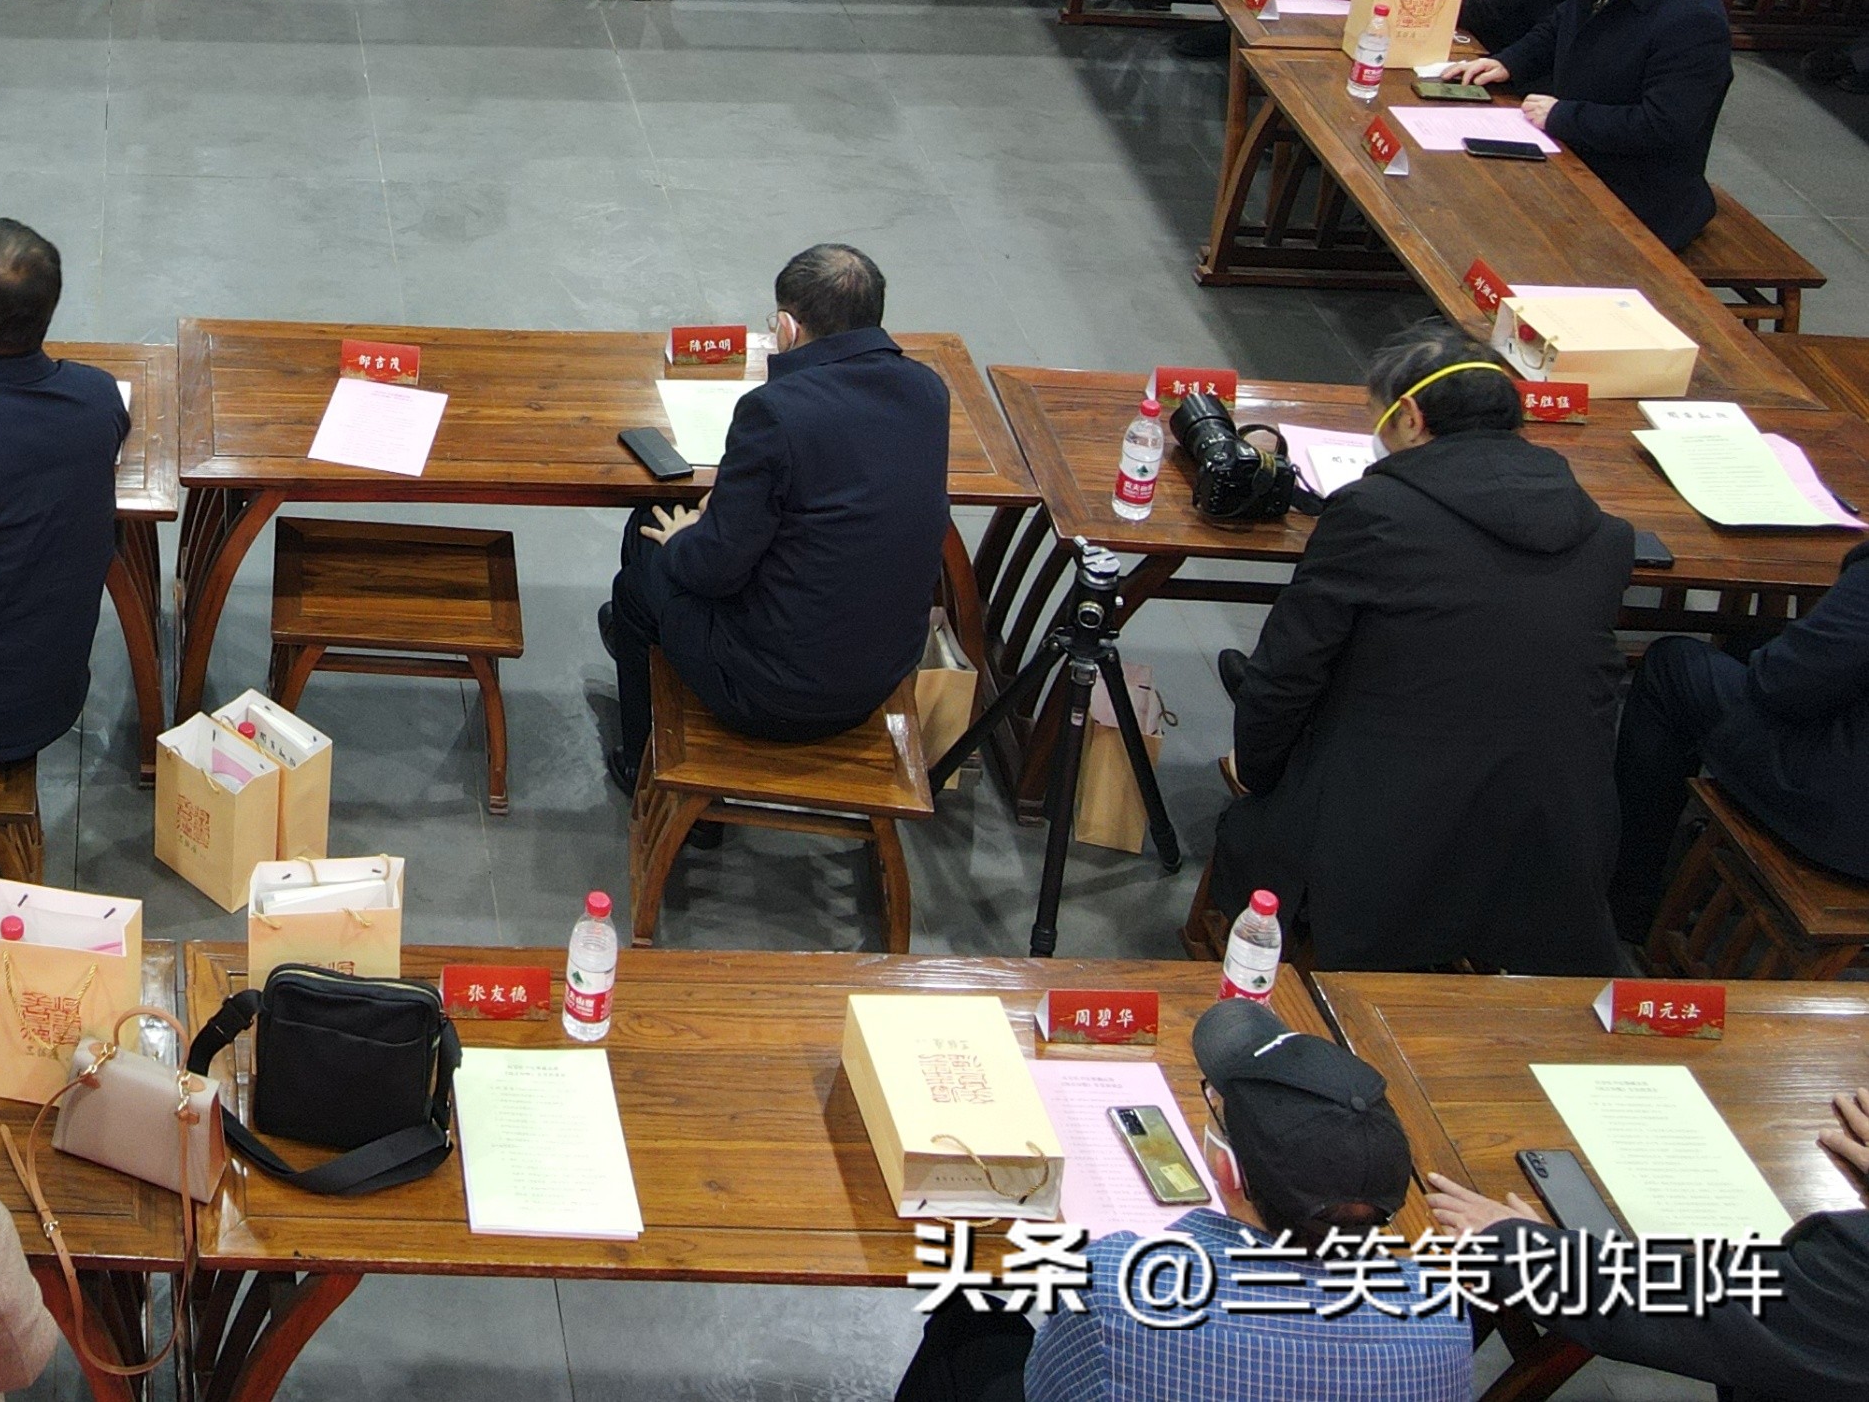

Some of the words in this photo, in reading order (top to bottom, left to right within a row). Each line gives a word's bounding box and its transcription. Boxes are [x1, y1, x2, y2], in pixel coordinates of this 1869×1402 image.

[467, 984, 528, 1004] 张友德
[1073, 1008, 1135, 1029] 周碧华
[1636, 1000, 1702, 1021] 周元法
